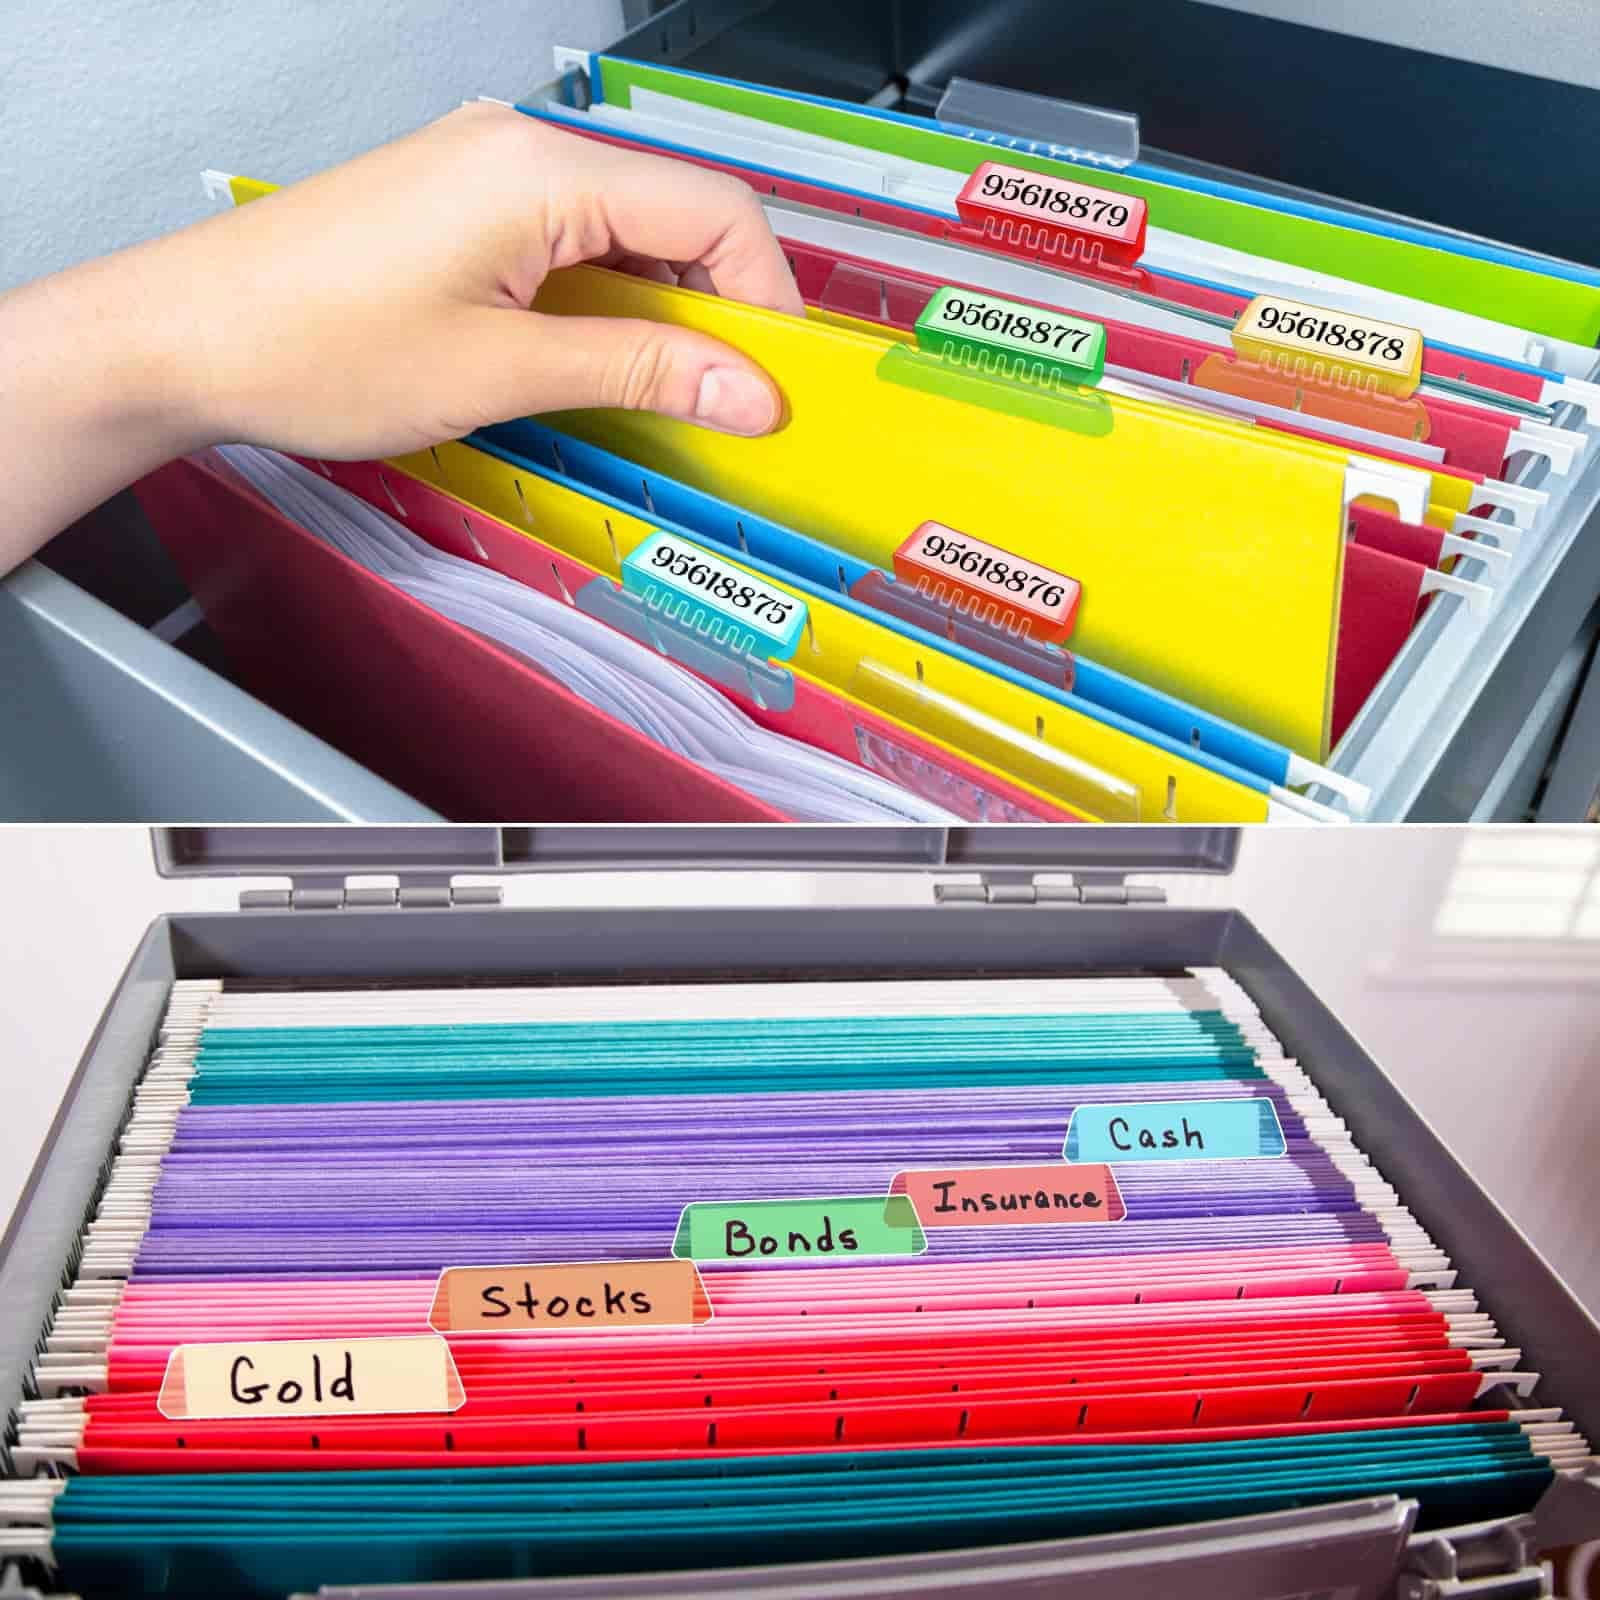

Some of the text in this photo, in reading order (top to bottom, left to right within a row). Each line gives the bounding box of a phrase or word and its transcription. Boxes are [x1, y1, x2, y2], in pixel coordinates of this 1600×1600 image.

[981, 173, 1132, 229] 95618879
[941, 297, 1093, 354] 95618877
[1256, 305, 1406, 363] 95618878
[650, 544, 792, 627] 95618875
[921, 533, 1066, 609] 95618876
[1109, 1117, 1205, 1151] Cash
[932, 1180, 1102, 1213] Insurance
[724, 1215, 859, 1258] Bonds
[480, 1282, 652, 1319] Stocks
[230, 1350, 355, 1405] Gold
